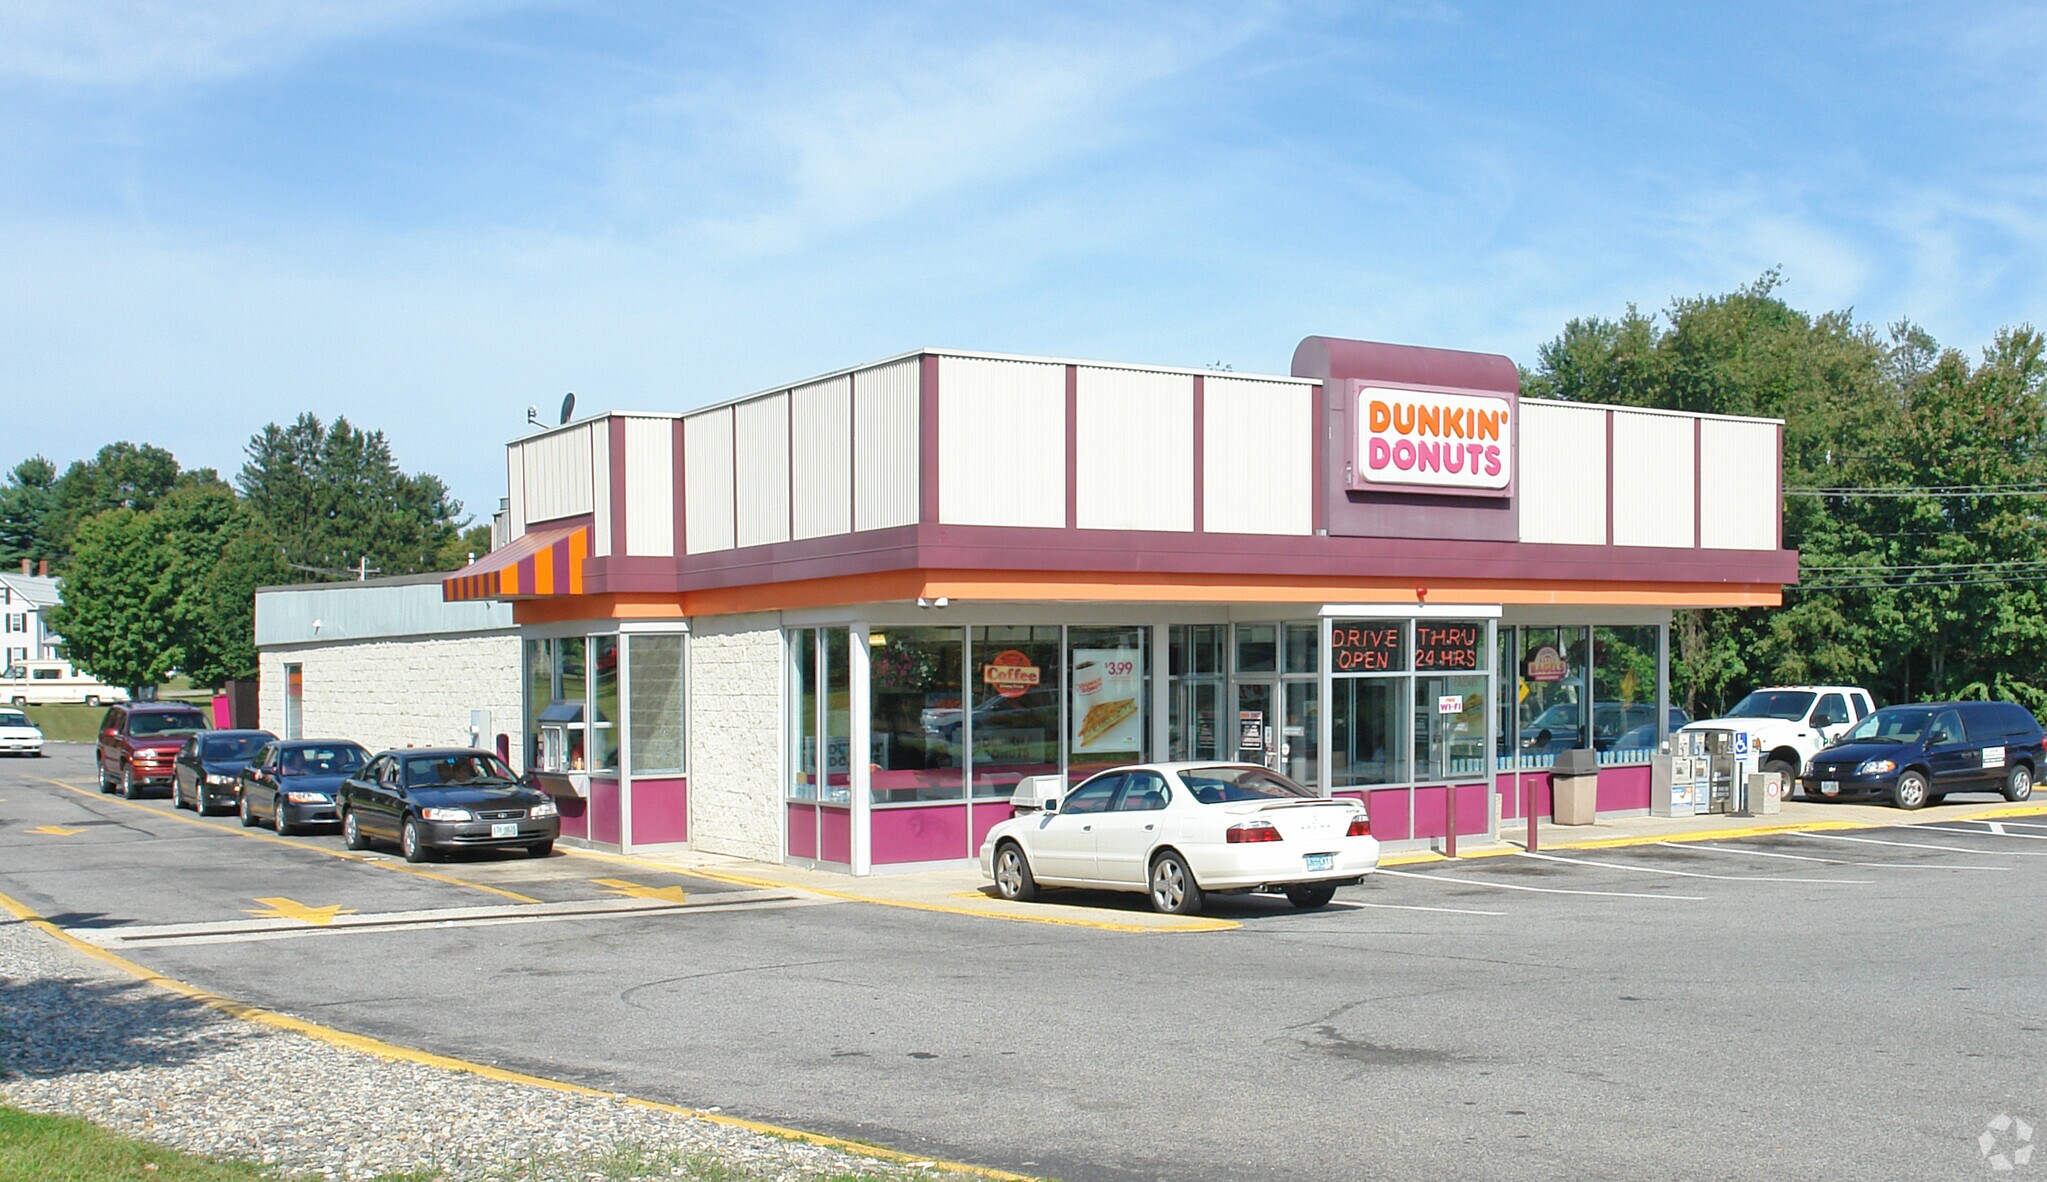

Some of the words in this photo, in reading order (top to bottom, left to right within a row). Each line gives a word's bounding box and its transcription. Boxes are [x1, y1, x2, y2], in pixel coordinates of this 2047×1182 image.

[1369, 400, 1508, 441] DUNKIN'
[1369, 437, 1502, 476] DONUTS
[1332, 629, 1398, 647] DRIVE
[1418, 629, 1475, 646] THRU
[1104, 661, 1133, 675] $3.99
[1338, 651, 1388, 668] OPEN
[1415, 650, 1434, 667] 24
[1441, 650, 1475, 667] HRS
[987, 667, 1037, 681] Coffee
